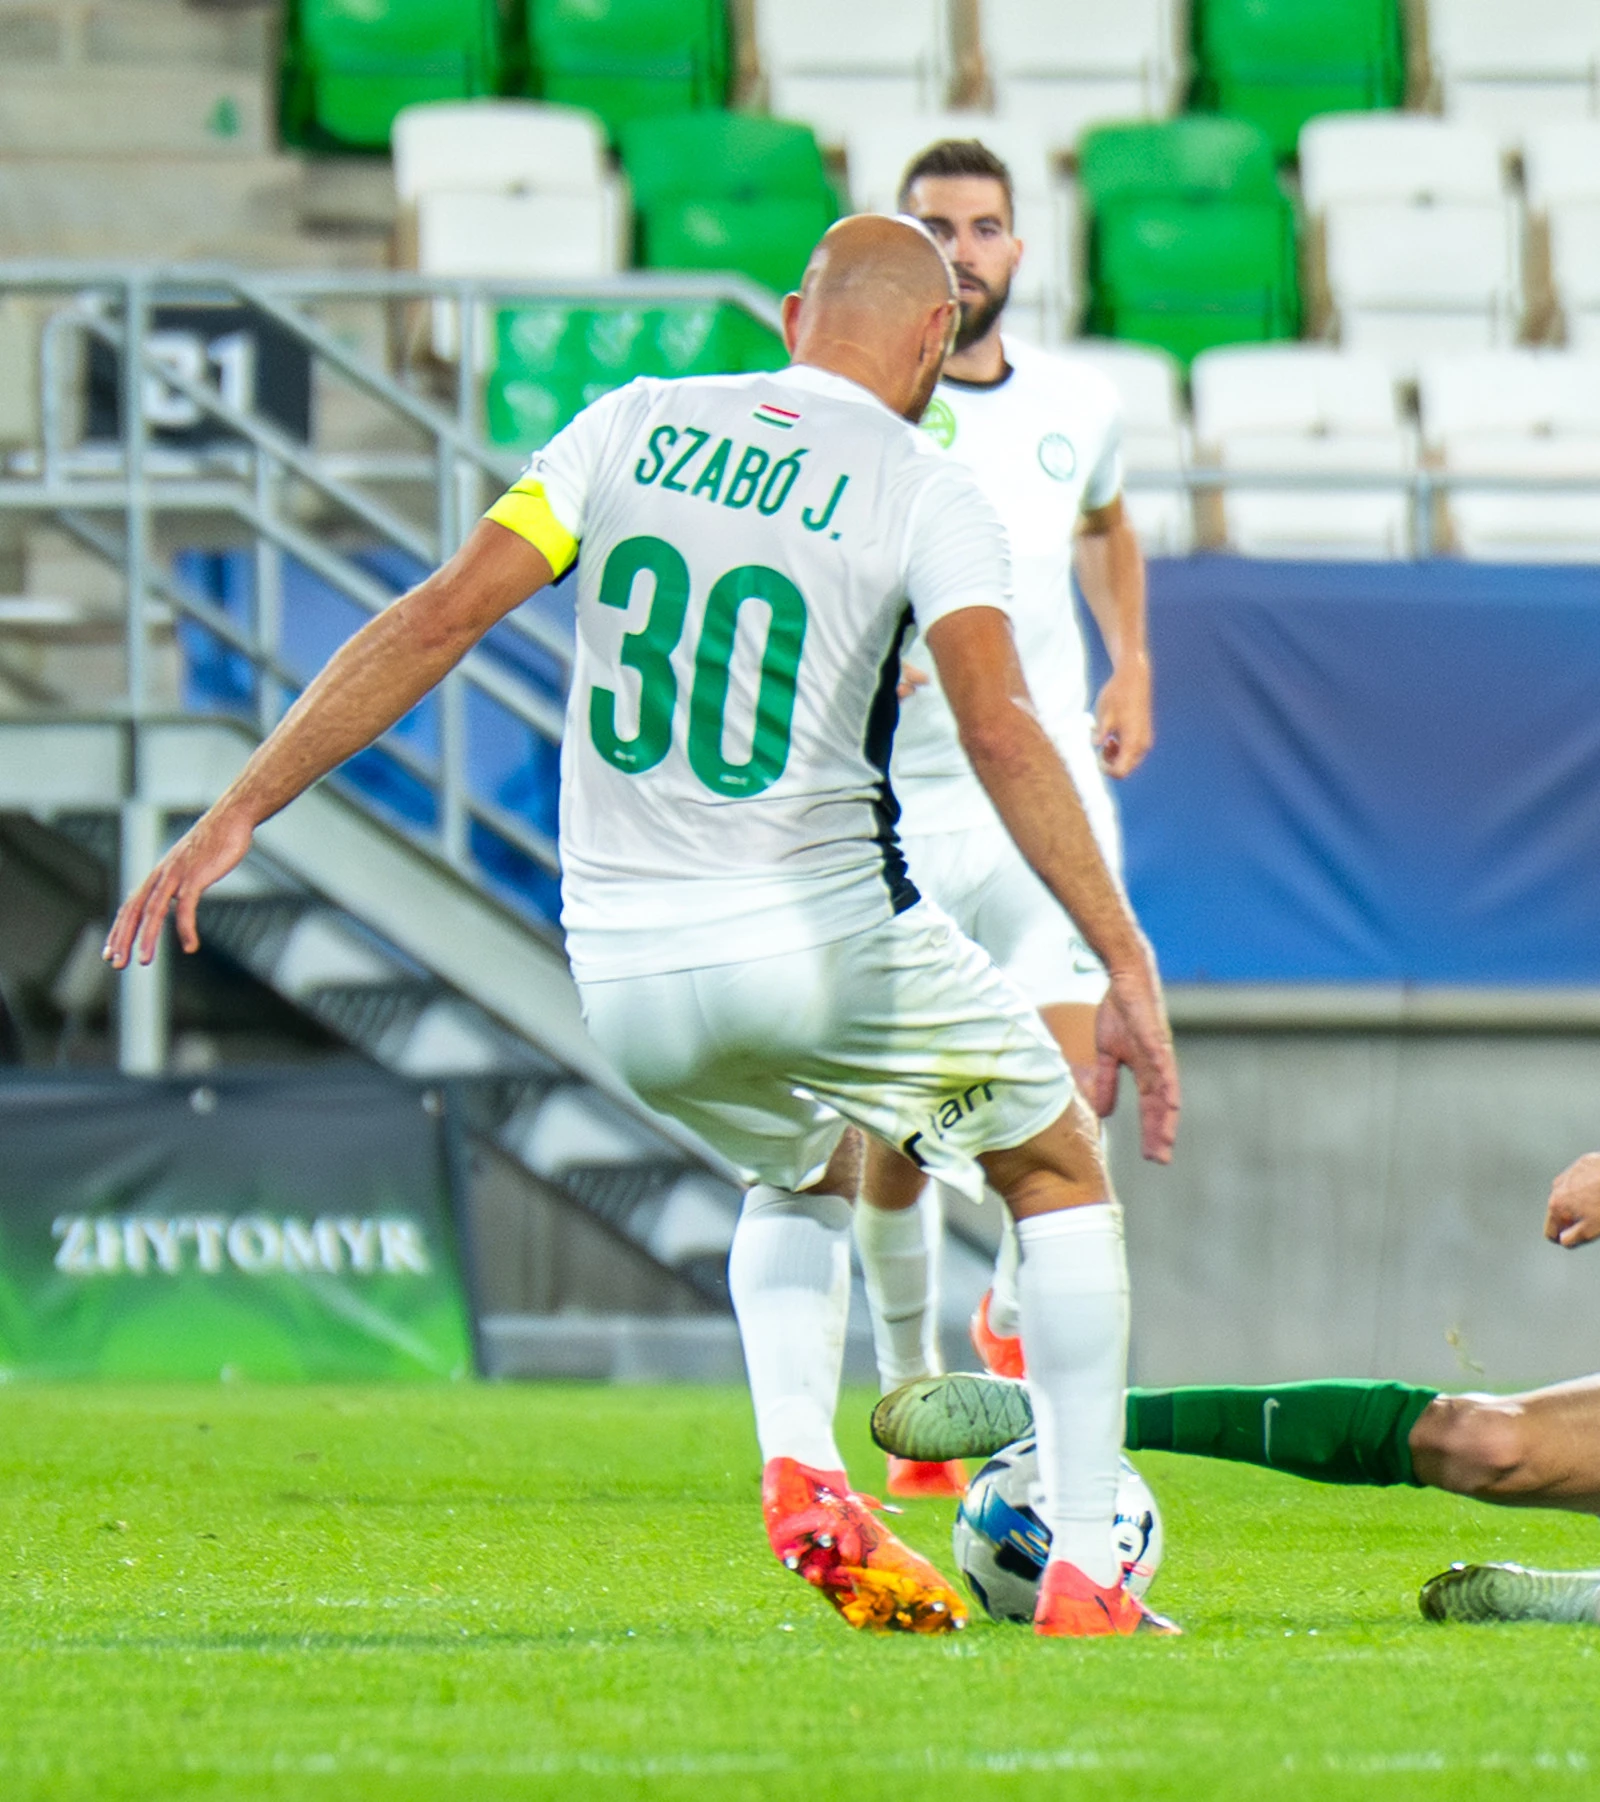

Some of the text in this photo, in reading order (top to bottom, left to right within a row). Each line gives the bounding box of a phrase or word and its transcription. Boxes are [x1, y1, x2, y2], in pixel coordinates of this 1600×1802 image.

[634, 424, 849, 541] SZABÓ J.
[588, 535, 809, 798] 30
[51, 1213, 430, 1274] ZHYTOMYR
